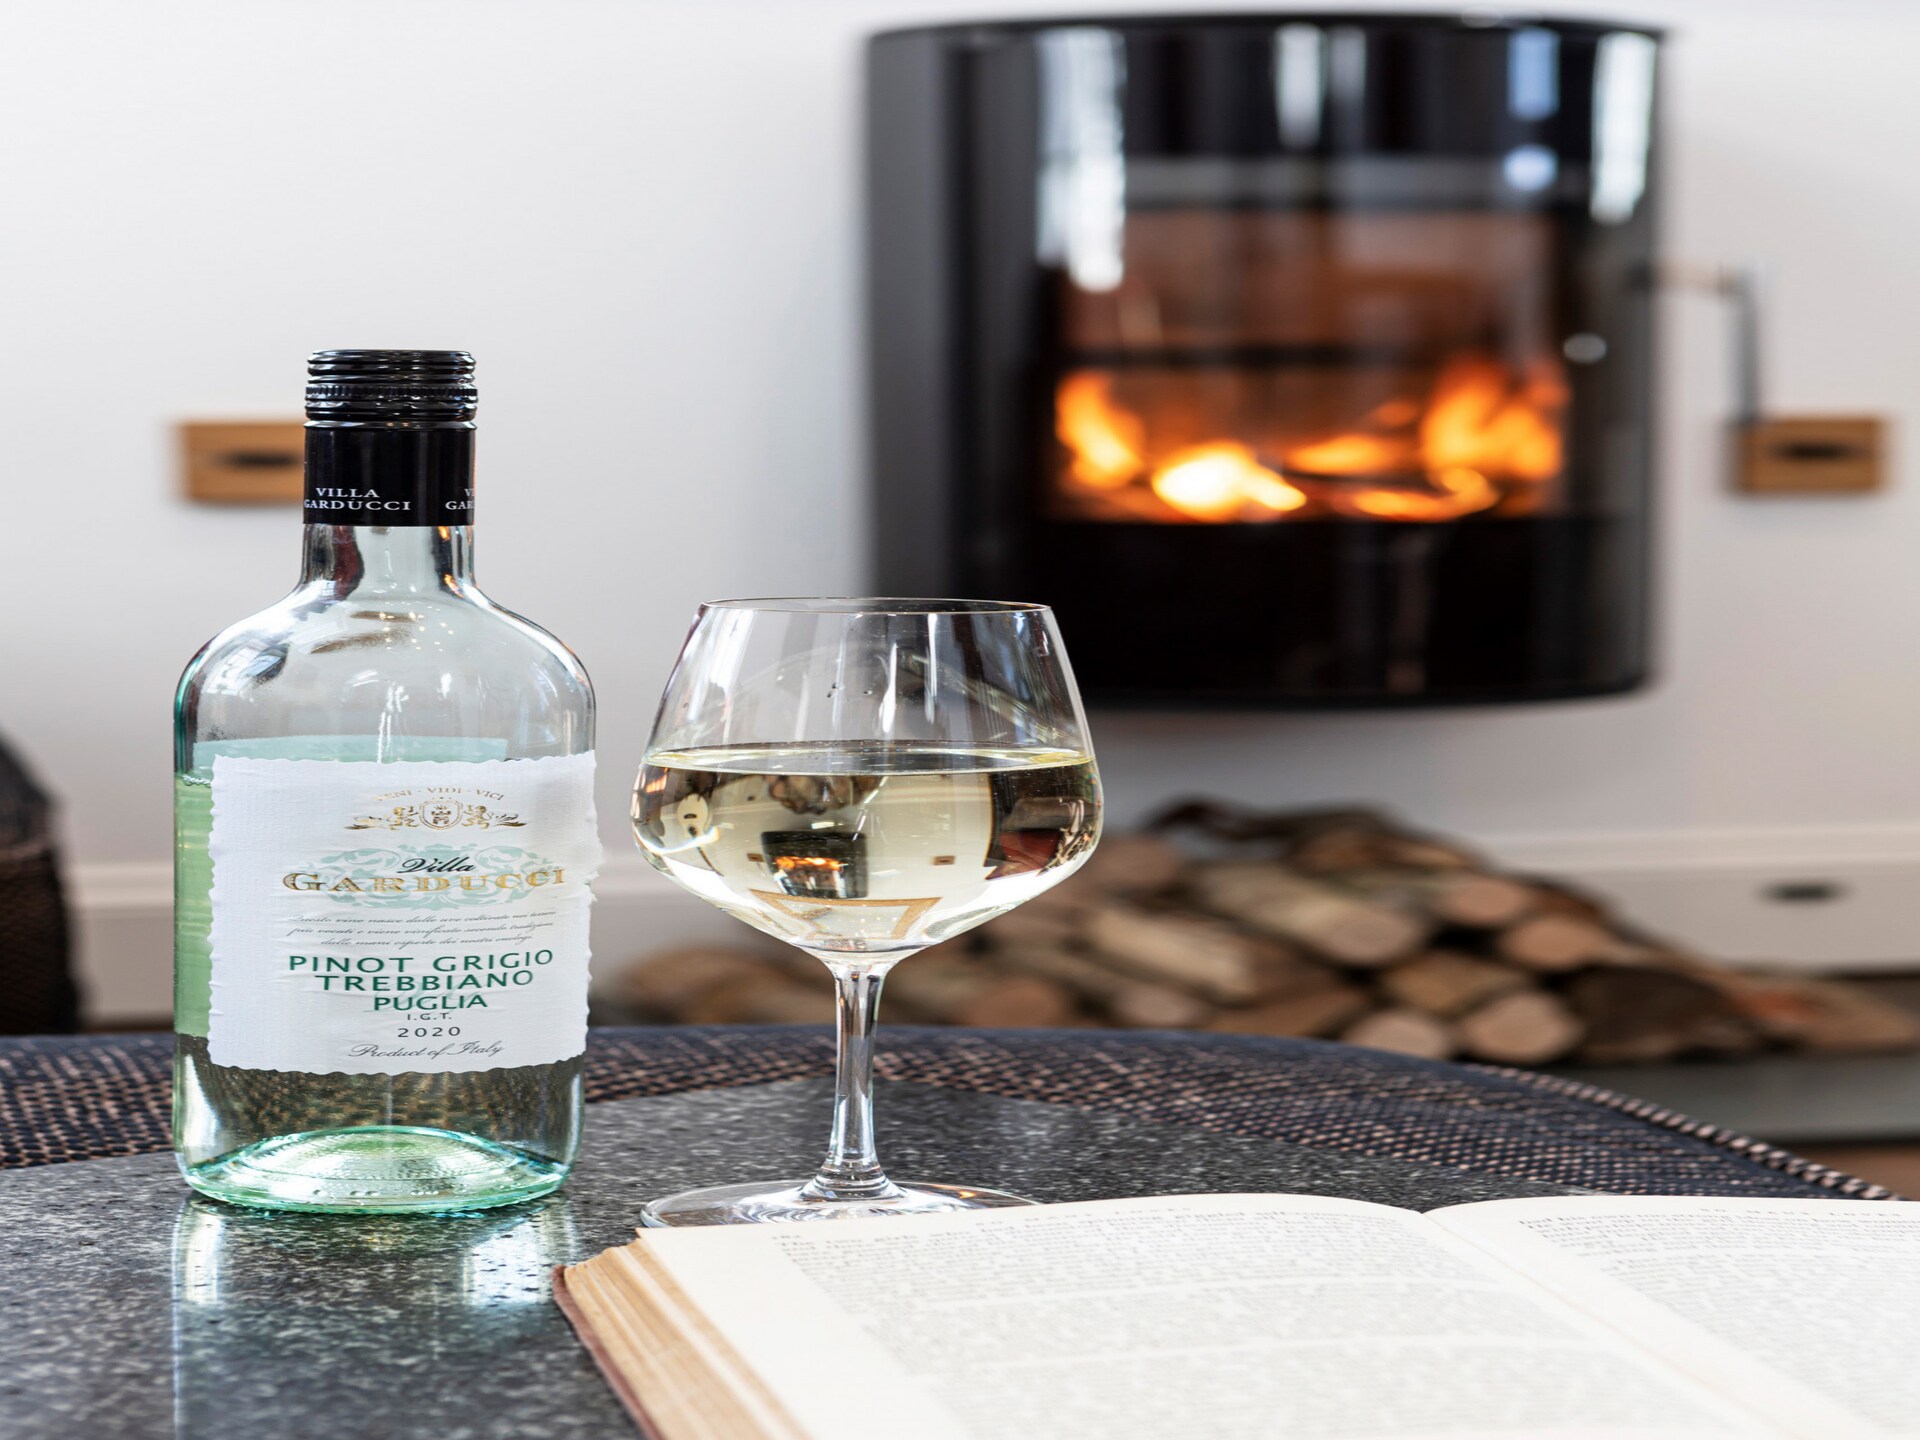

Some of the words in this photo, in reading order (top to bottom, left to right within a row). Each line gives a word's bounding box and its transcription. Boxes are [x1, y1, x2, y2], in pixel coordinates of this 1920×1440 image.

[315, 487, 380, 498] VILLA
[303, 499, 412, 511] GARDUCCI
[476, 789, 504, 801] VICI
[396, 856, 477, 874] Villa
[282, 868, 567, 893] GARDUCCI
[289, 955, 414, 973] PINOT
[432, 949, 554, 972] GRIGIO
[314, 970, 534, 991] TREBBIANO
[373, 994, 489, 1011] PUGLIA
[407, 1012, 452, 1021] I.G.T.
[397, 1026, 461, 1038] 2020
[348, 1042, 425, 1058] Product
[427, 1042, 455, 1060] of
[455, 1040, 505, 1058] Italy
